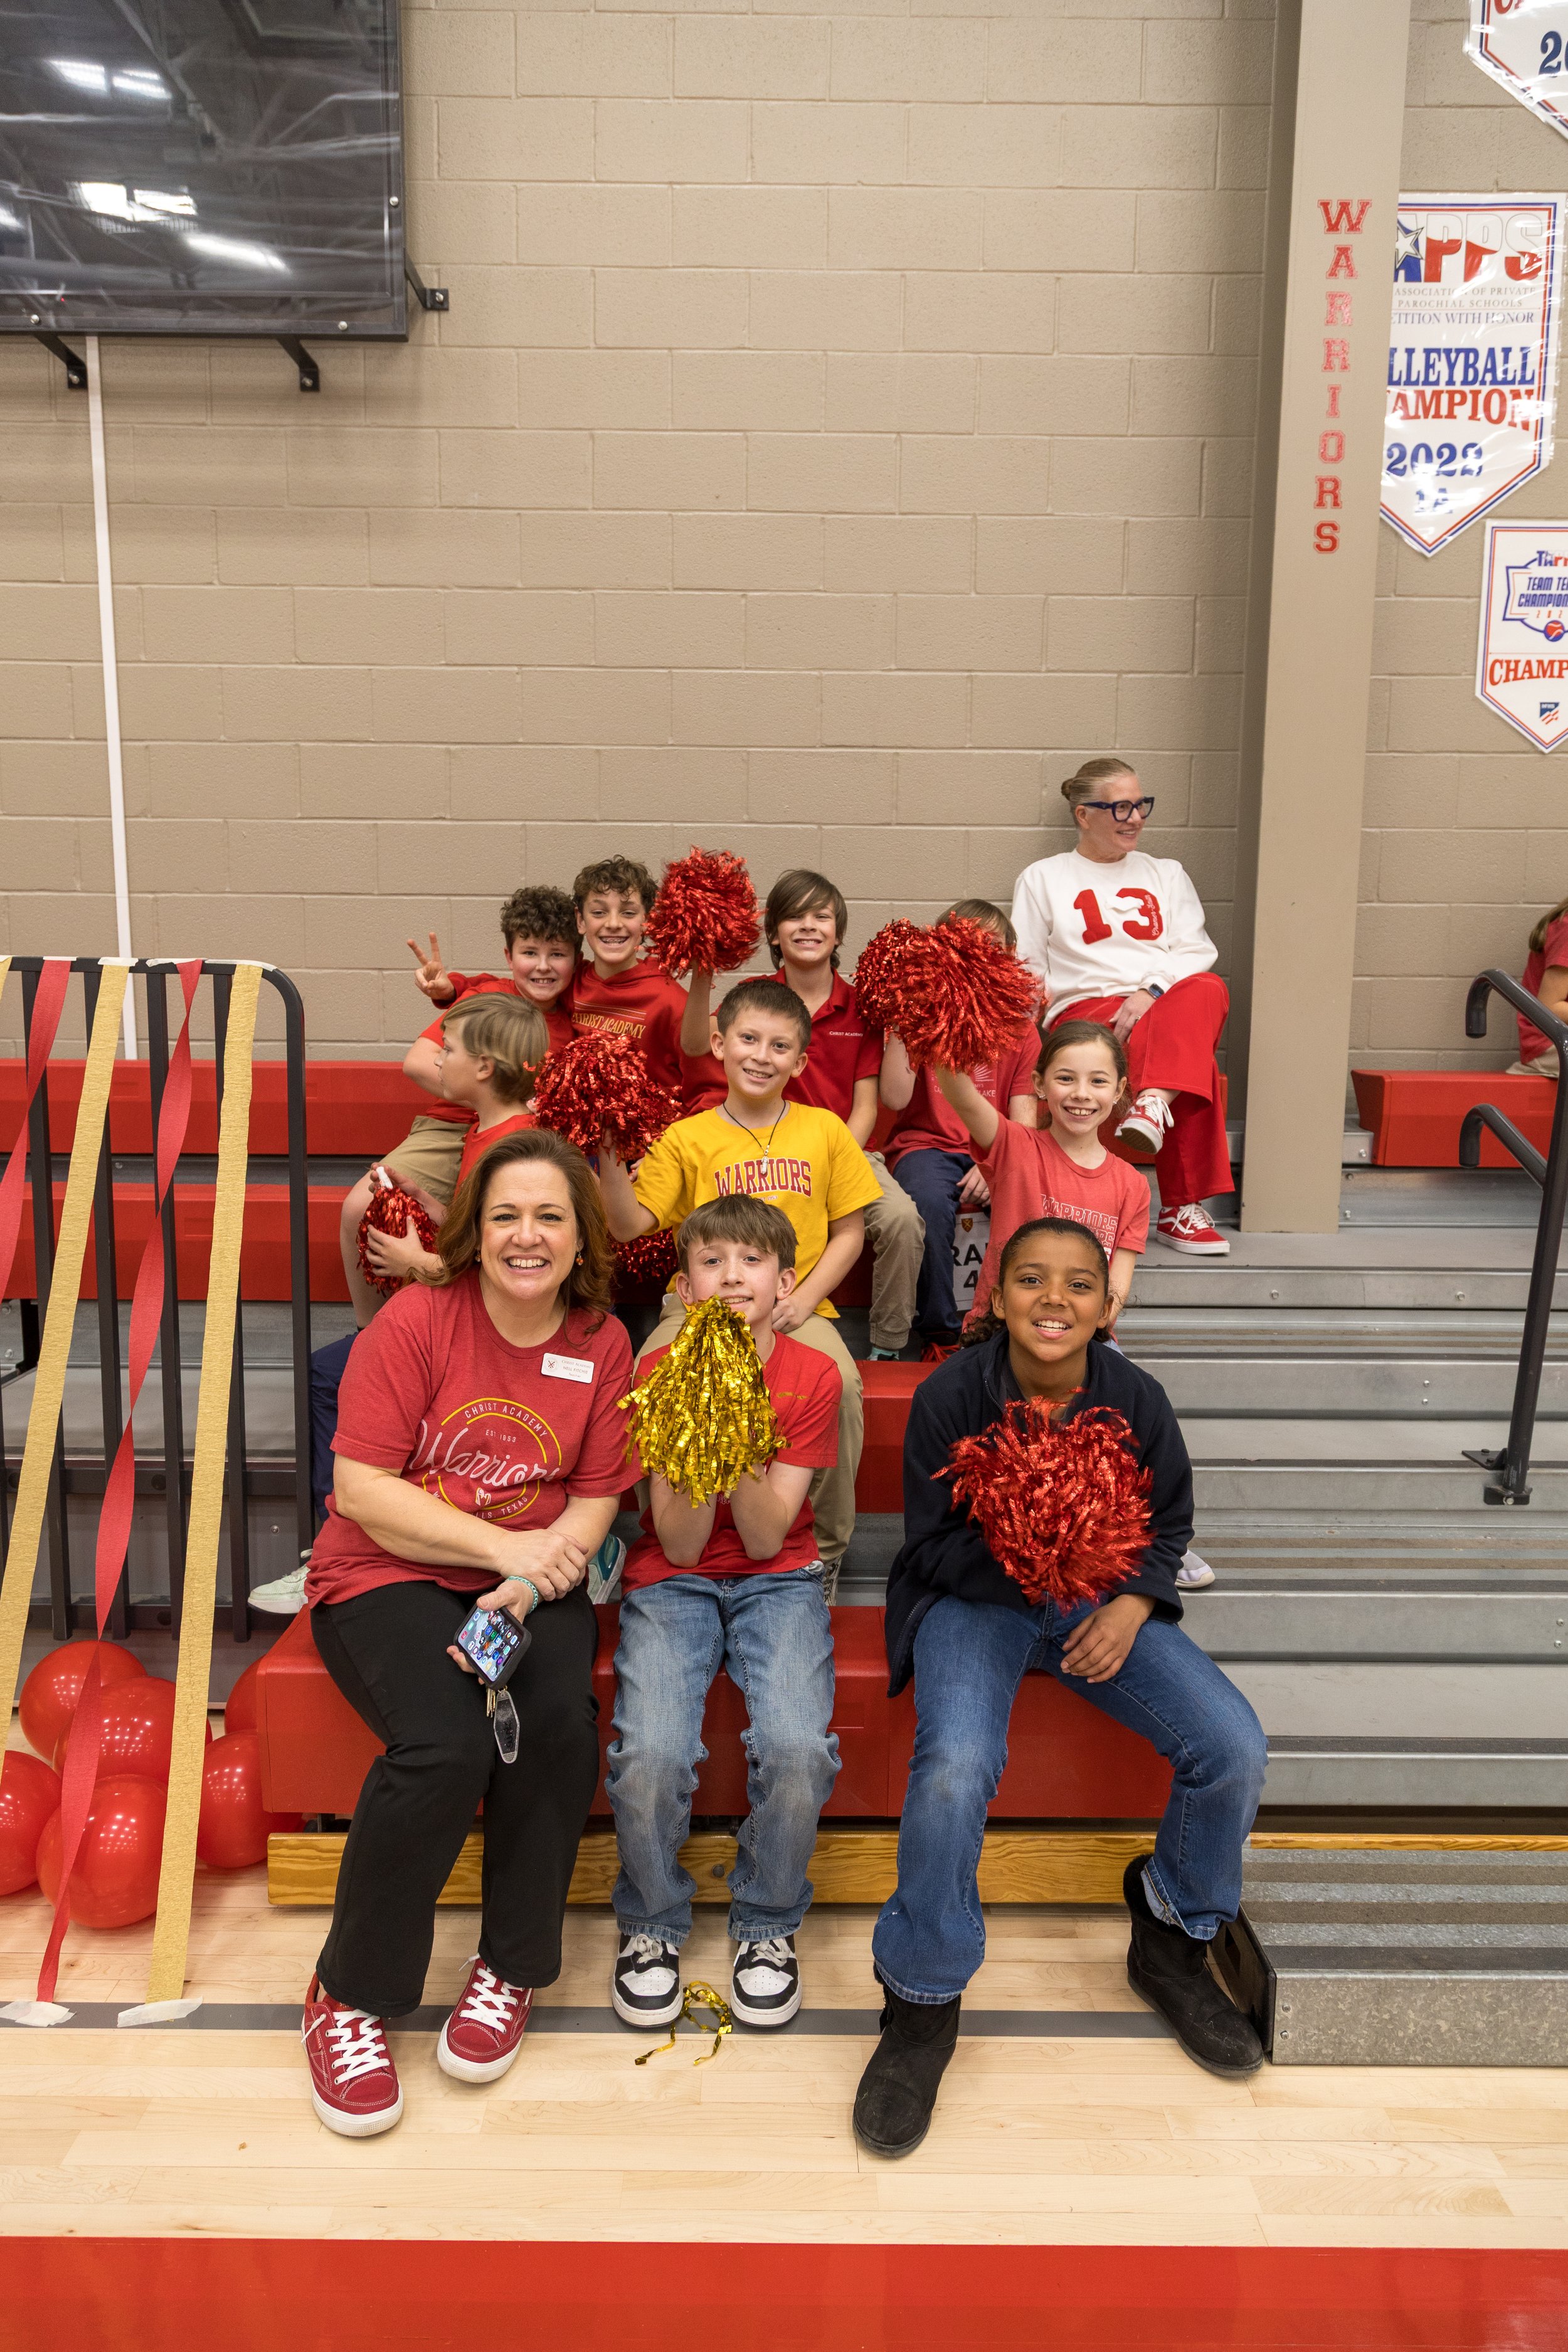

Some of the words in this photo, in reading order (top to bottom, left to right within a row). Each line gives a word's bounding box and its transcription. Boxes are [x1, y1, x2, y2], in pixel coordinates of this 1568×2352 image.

[1538, 30, 1568, 78] 2
[1394, 288, 1467, 296] ASSOCIATI
[1445, 312, 1481, 324] WITH
[1486, 312, 1534, 324] HONOR
[1313, 199, 1373, 554] WARRIORS
[1387, 388, 1534, 432] AMPION
[1527, 577, 1553, 591] TEAM
[1557, 577, 1568, 591] TE
[1073, 887, 1163, 945] 13
[571, 1012, 604, 1029] CHRIST
[600, 1017, 647, 1039] ACADEMY
[714, 1158, 812, 1198] WARRIORS
[951, 1242, 989, 1267] RA
[963, 1270, 978, 1291] 4
[464, 1402, 497, 1419] CHRIST
[502, 1405, 548, 1438] ACADEMY
[499, 1434, 516, 1443] 1953
[501, 1496, 528, 1515] TEXAS
